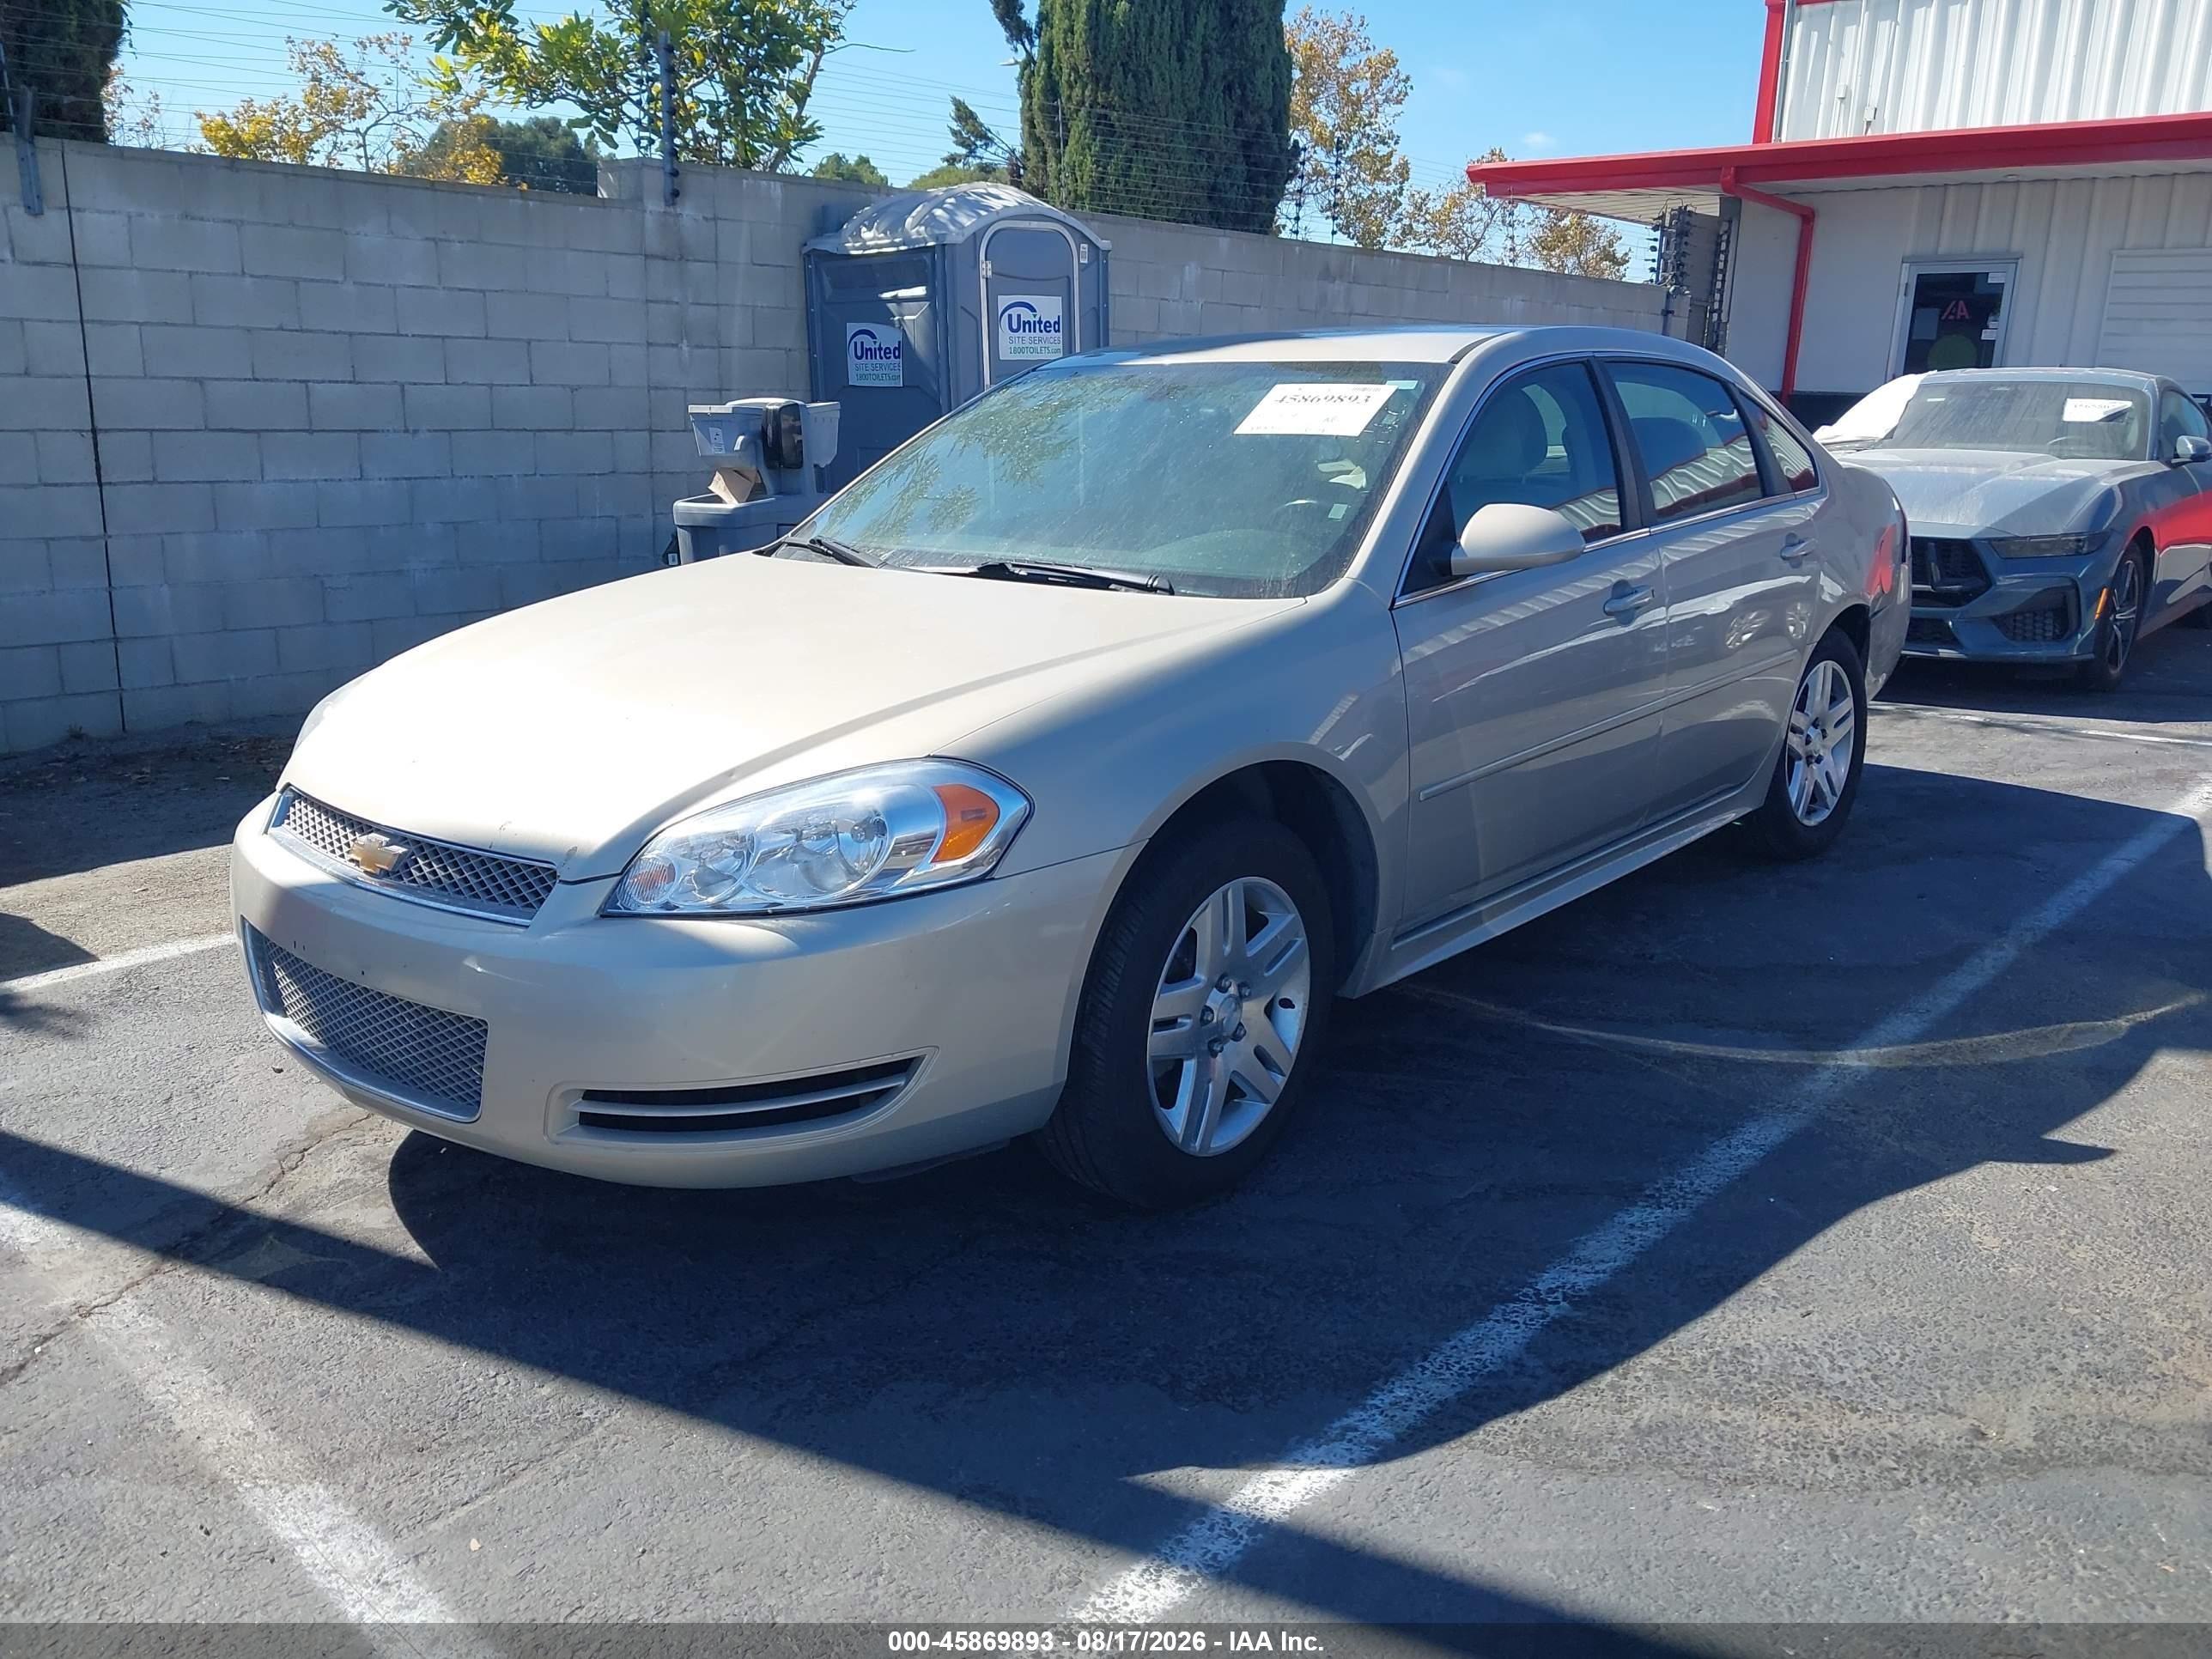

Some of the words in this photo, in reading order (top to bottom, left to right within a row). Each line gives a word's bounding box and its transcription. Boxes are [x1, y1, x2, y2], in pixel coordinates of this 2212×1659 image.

[1007, 313, 1061, 334] United
[1008, 336, 1026, 344] SITE
[1028, 336, 1061, 344] SERVICES
[854, 340, 901, 361] United
[1009, 346, 1061, 355] 1800TOILETS.com
[854, 362, 869, 372] SITE
[871, 362, 901, 372] SERVICES
[1273, 393, 1371, 404] 45869893
